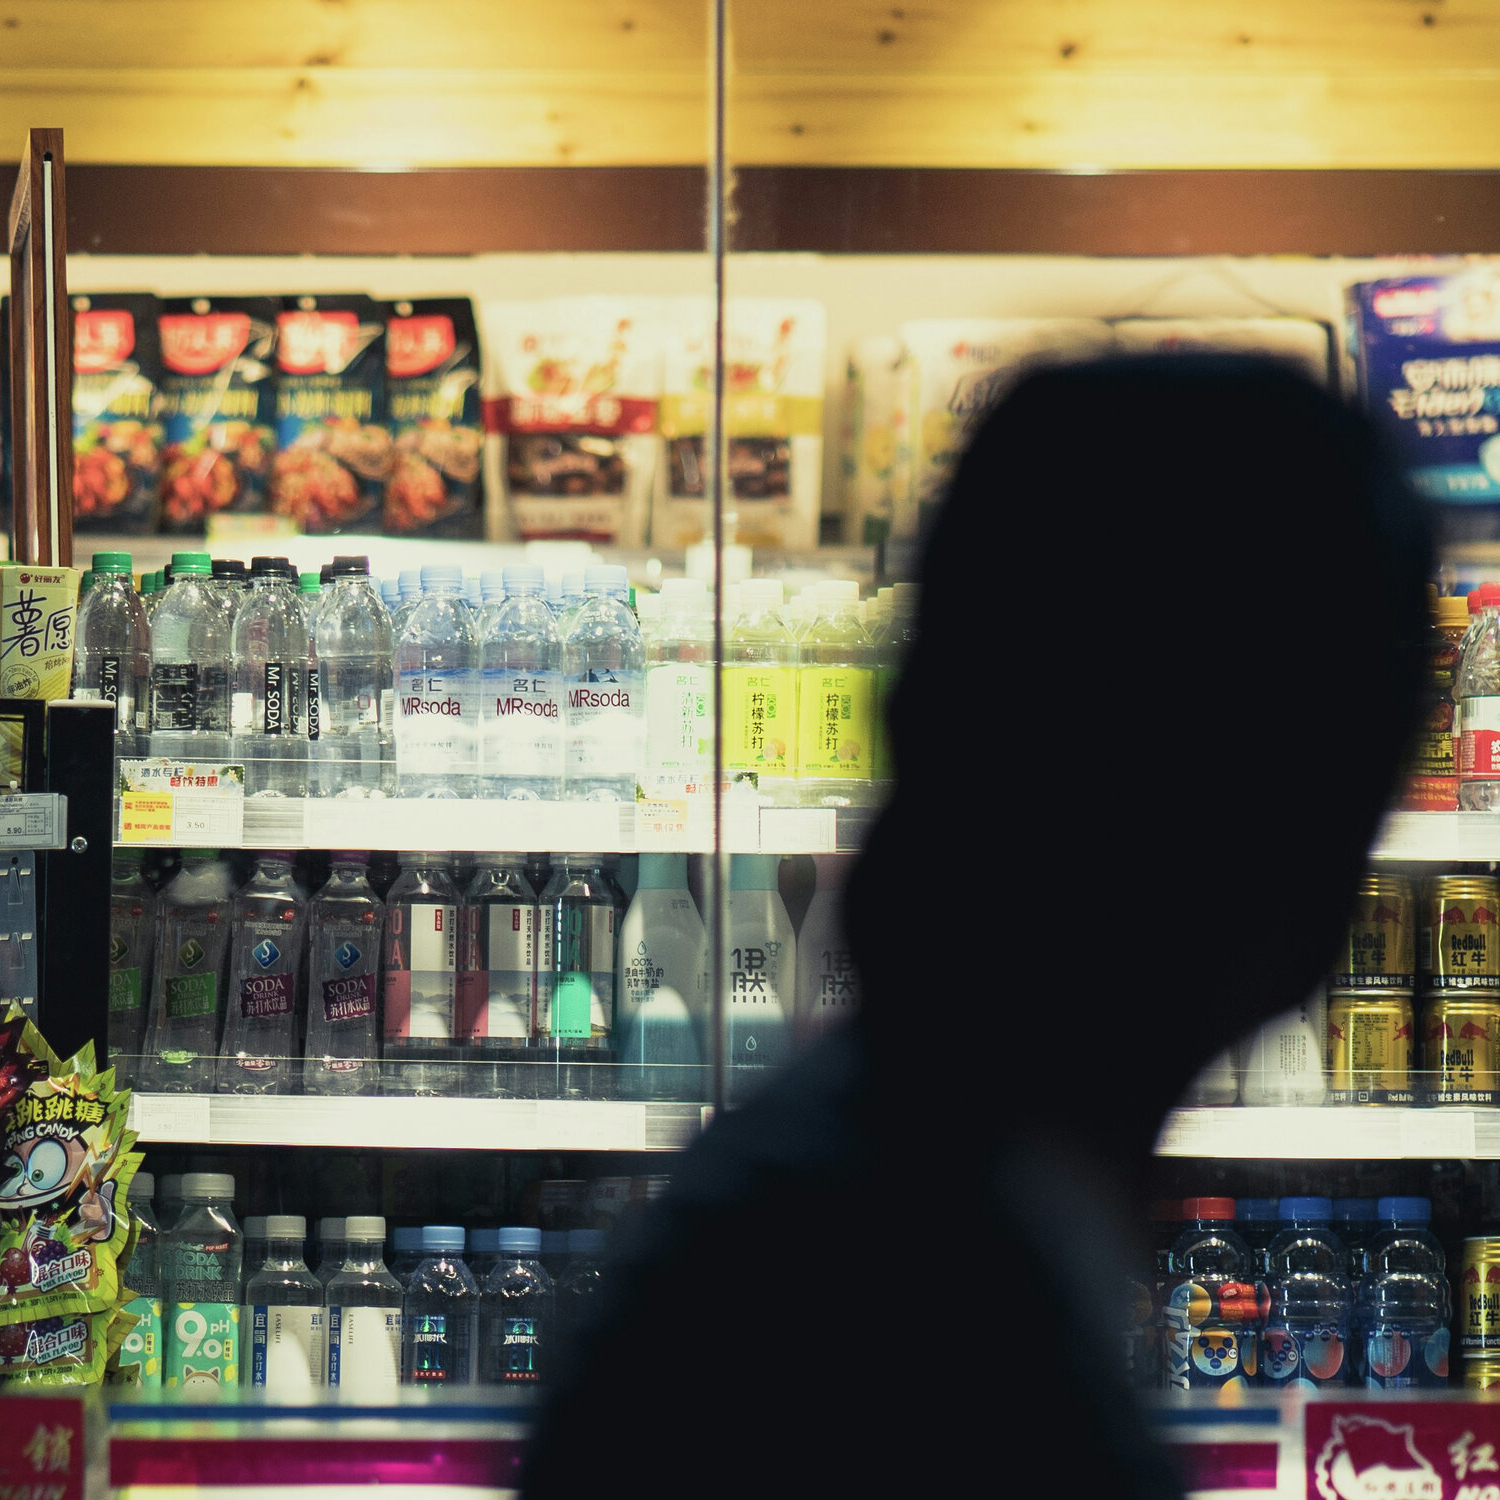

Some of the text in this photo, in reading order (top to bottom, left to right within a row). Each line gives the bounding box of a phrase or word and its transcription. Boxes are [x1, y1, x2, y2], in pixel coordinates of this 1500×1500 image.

[1, 589, 73, 659] 薯愿
[411, 679, 443, 692] 名仁
[513, 679, 546, 693] 名仁
[747, 677, 771, 687] 名仁
[822, 678, 845, 688] 名仁
[267, 666, 281, 730] Mr.SODA
[401, 697, 461, 716] MRsoda
[568, 689, 630, 709] MRsoda
[496, 698, 558, 717] MRsoda
[752, 693, 764, 749] 柠檬苏打
[826, 694, 839, 750] 柠檬苏打
[170, 776, 218, 787] 畅饮特惠
[187, 821, 205, 829] 3.50
[1451, 934, 1486, 950] RedBull
[1451, 951, 1486, 967] 红牛
[246, 978, 285, 995] SODA
[328, 980, 367, 998] SODA
[247, 997, 287, 1014] 苏打水饮品
[330, 997, 371, 1017] 苏打水饮品
[1440, 1049, 1474, 1065] RedBull
[1441, 1066, 1474, 1083] 红牛
[35, 1123, 79, 1140] CANDY
[34, 1251, 91, 1283] 混合口味
[176, 1252, 220, 1266] SODA
[176, 1266, 222, 1280] DRINK
[42, 1279, 56, 1291] MIX
[176, 1281, 235, 1302] 苏打水饮品
[1469, 1311, 1500, 1327] 红牛
[30, 1326, 87, 1356] 混合口味
[175, 1311, 230, 1359] 9.0 pH
[1448, 1431, 1500, 1480] 红
